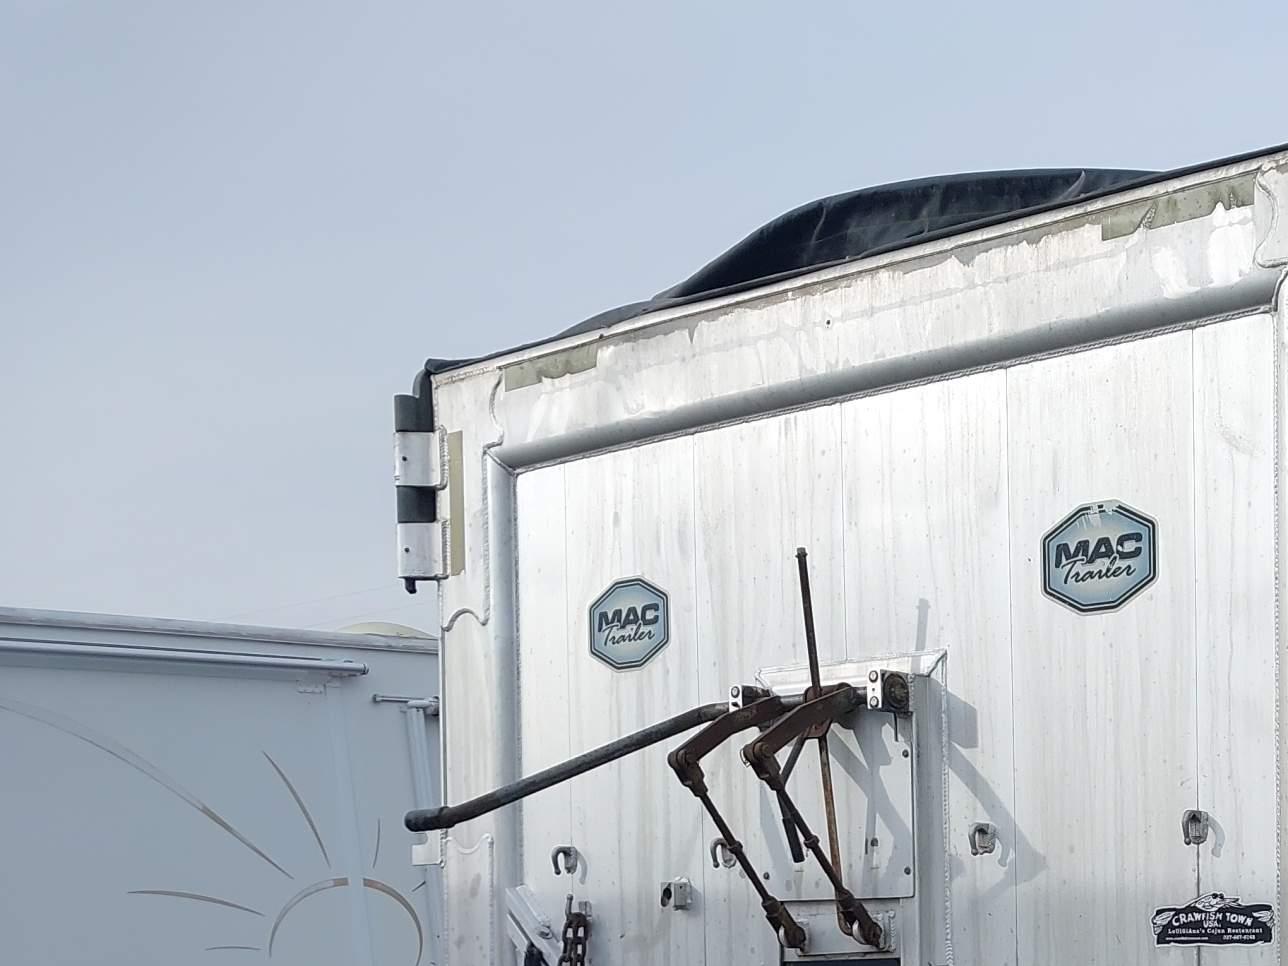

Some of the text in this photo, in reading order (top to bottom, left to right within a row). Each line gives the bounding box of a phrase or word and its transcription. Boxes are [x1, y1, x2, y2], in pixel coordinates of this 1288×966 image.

[1054, 532, 1143, 569] MAC
[1061, 555, 1137, 585] Trailer
[597, 602, 660, 633] MAC
[602, 622, 656, 646] Trailer
[1171, 911, 1254, 927] CRAWFISH TOWN
